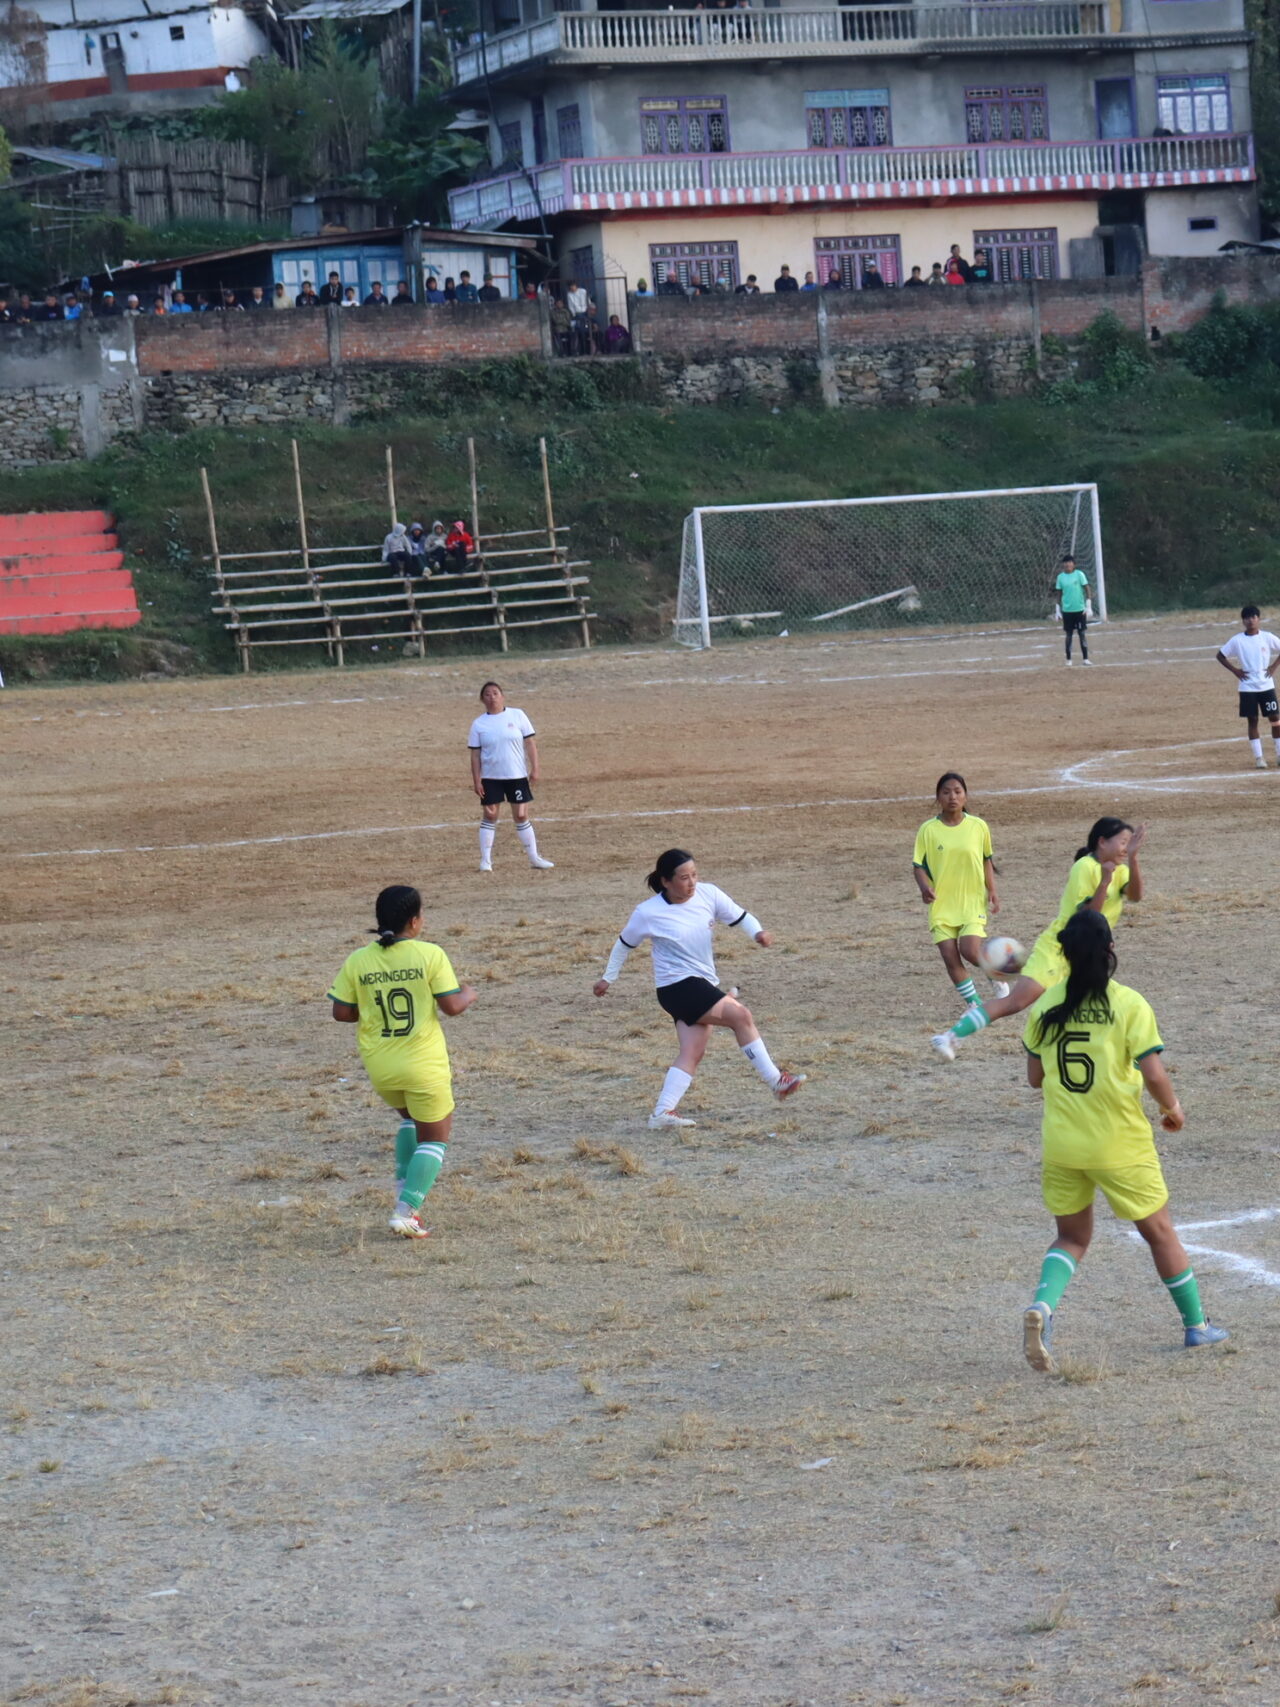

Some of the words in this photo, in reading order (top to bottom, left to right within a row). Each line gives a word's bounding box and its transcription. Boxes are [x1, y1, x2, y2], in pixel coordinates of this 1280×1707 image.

[1265, 701, 1278, 711] 30
[514, 790, 523, 801] 2
[359, 968, 424, 985] MERINGDEN
[374, 987, 415, 1038] 19
[1057, 1031, 1095, 1094] 6
